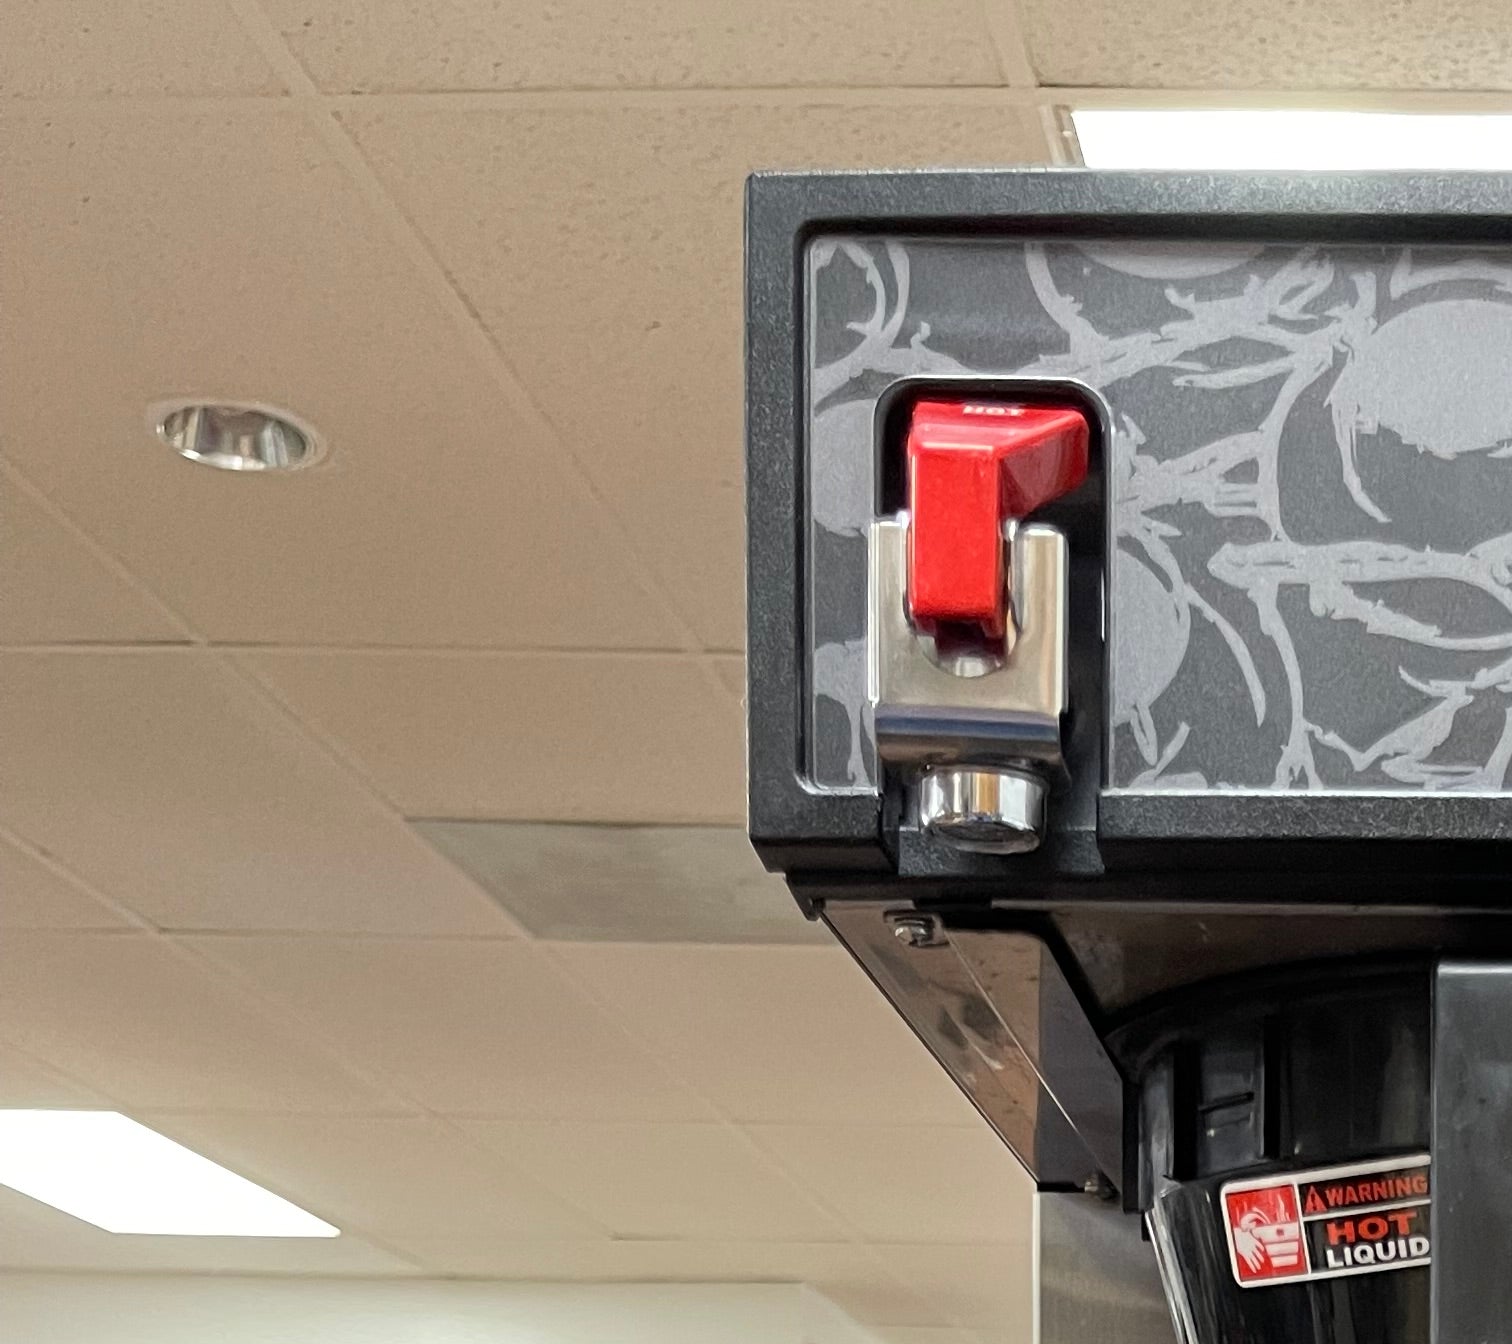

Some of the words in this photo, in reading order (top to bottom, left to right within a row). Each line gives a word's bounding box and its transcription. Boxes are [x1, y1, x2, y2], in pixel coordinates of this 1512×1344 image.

[1324, 1174, 1428, 1207] WARNING
[1325, 1209, 1418, 1245] HOT
[1326, 1236, 1430, 1268] LIQUID
